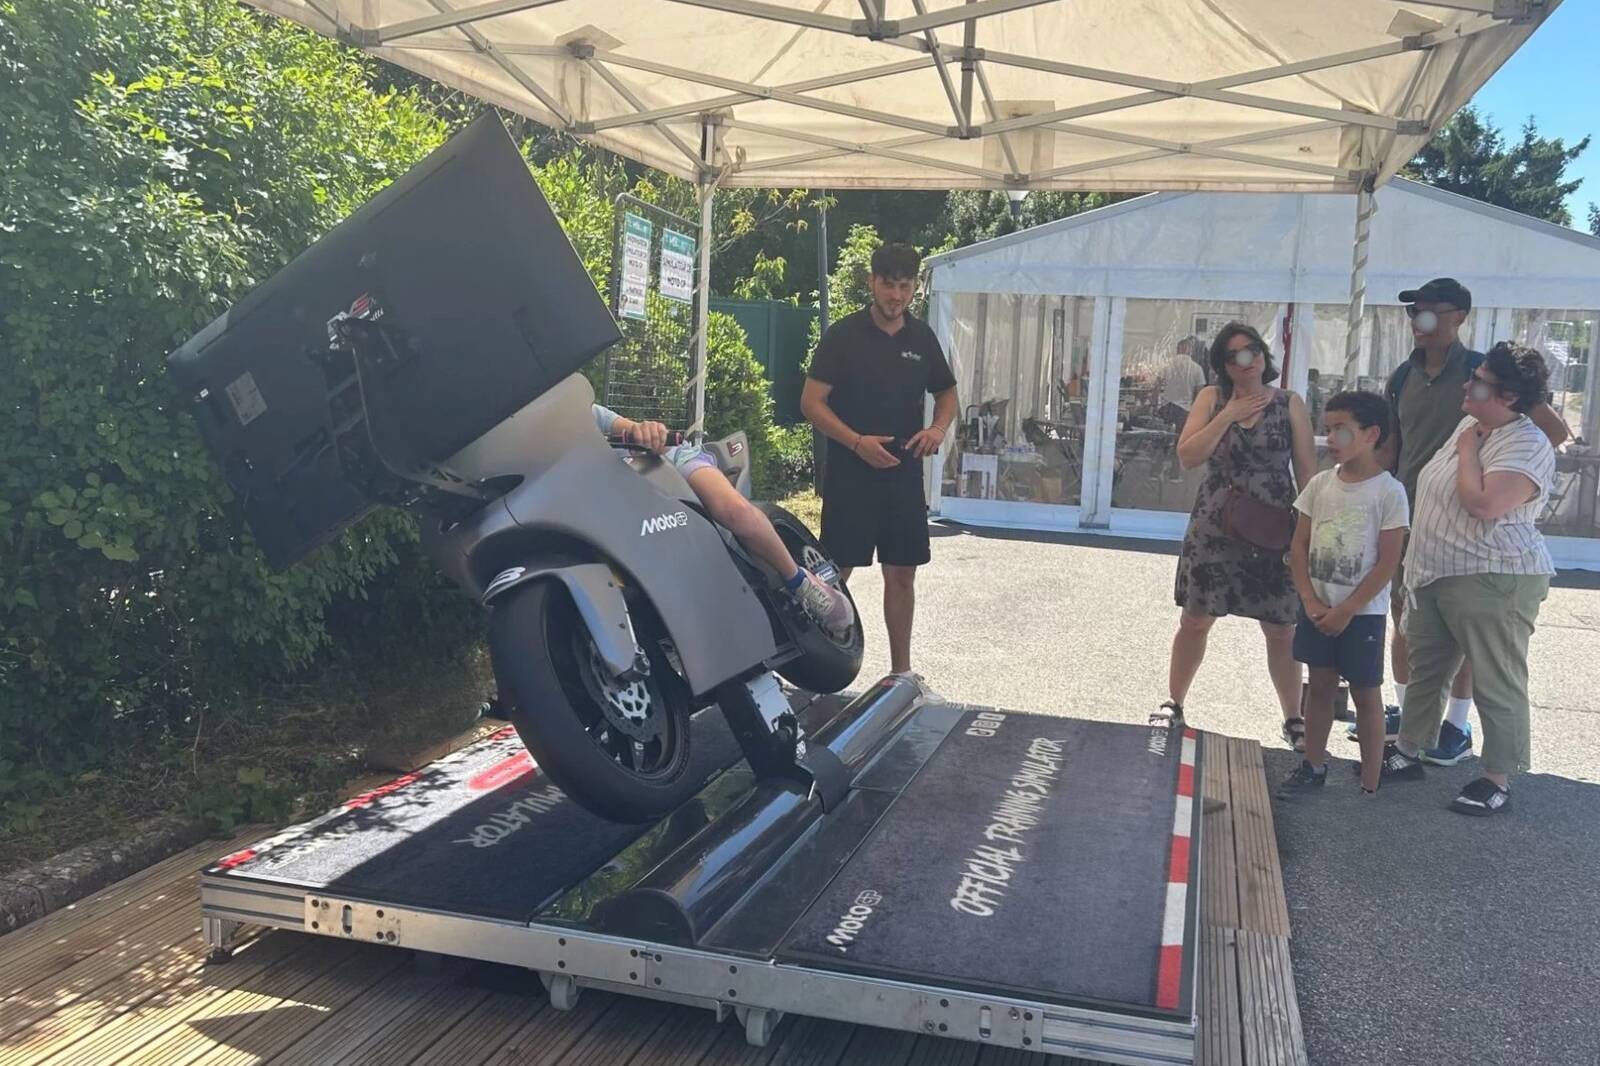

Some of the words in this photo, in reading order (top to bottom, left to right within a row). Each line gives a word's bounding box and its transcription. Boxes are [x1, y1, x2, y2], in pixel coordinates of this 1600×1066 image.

[1009, 737, 1068, 794] SIMULATOR
[982, 790, 1048, 845] TRAINING
[950, 844, 1025, 917] OFFICIAL
